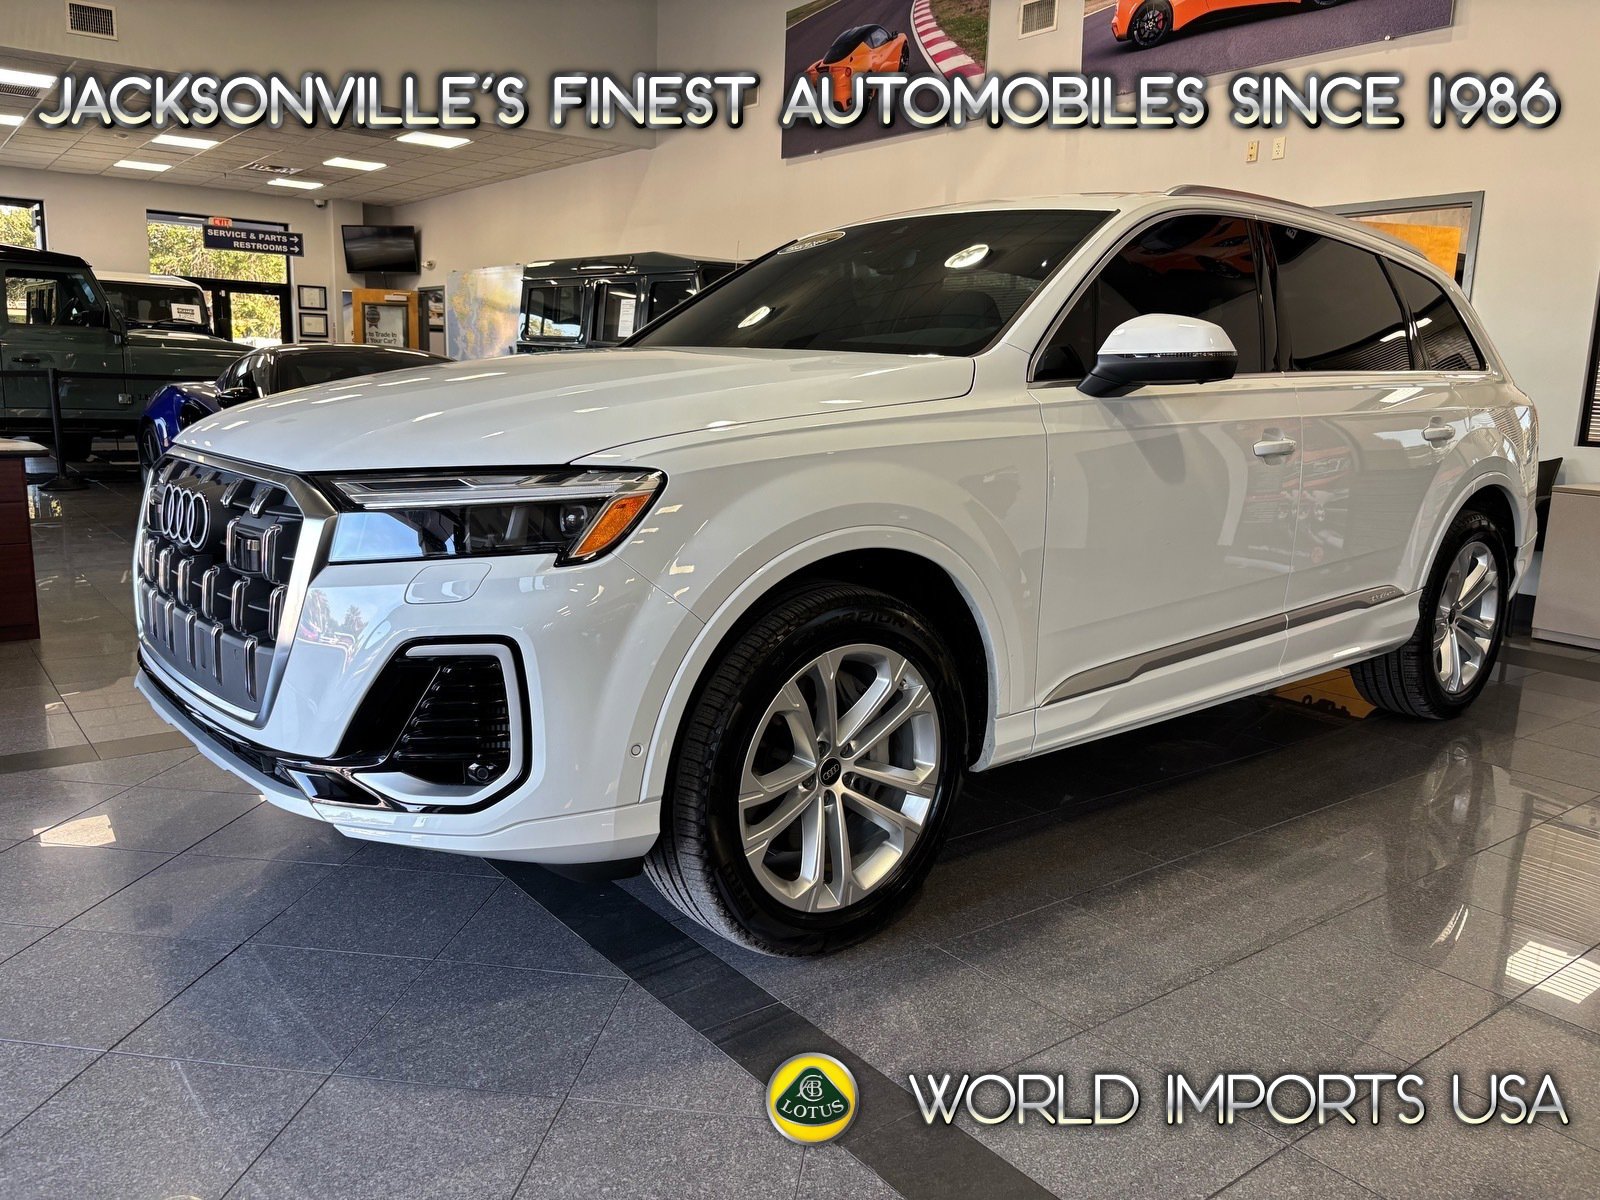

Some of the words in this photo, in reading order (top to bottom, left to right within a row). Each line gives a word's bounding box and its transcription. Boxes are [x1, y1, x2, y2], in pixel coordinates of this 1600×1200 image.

[207, 228, 247, 239] SERVICE
[249, 232, 257, 240] &
[258, 233, 288, 243] PARTS
[233, 240, 289, 253] RESTROOMS
